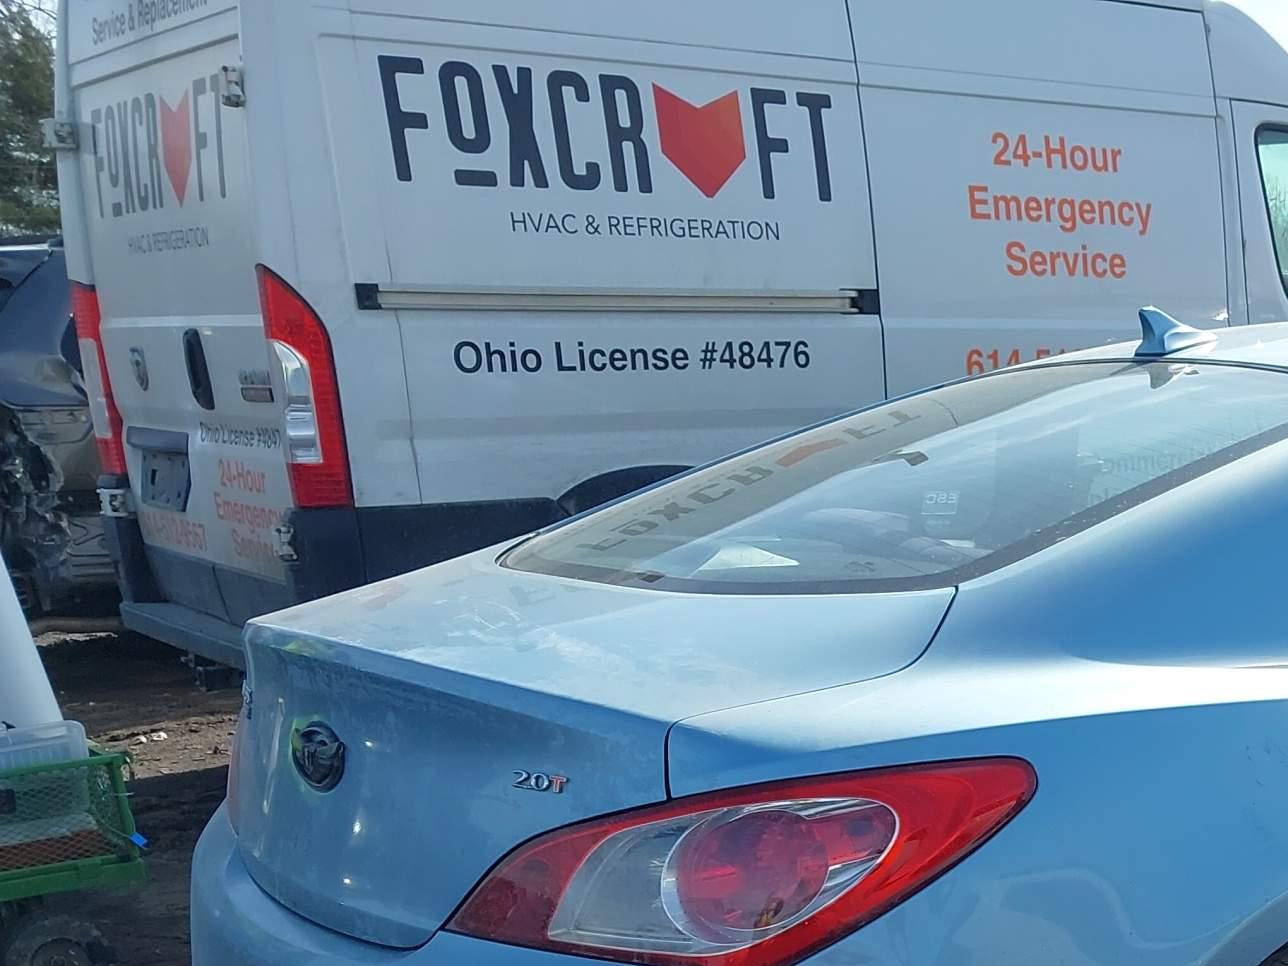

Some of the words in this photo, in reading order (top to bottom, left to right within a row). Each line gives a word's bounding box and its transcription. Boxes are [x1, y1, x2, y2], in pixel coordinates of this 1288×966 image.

[91, 10, 126, 46] Service
[128, 3, 136, 31] &
[991, 132, 1122, 173] 24-Hour
[510, 211, 577, 235] HVAC
[585, 214, 601, 236] &
[607, 216, 781, 241] REFRIGERATION
[967, 185, 1152, 236] Emergency
[1005, 241, 1127, 279] Service
[452, 340, 543, 374] Ohio
[554, 341, 690, 372] License
[699, 340, 811, 370] #48476
[218, 458, 267, 495] 24-Hour
